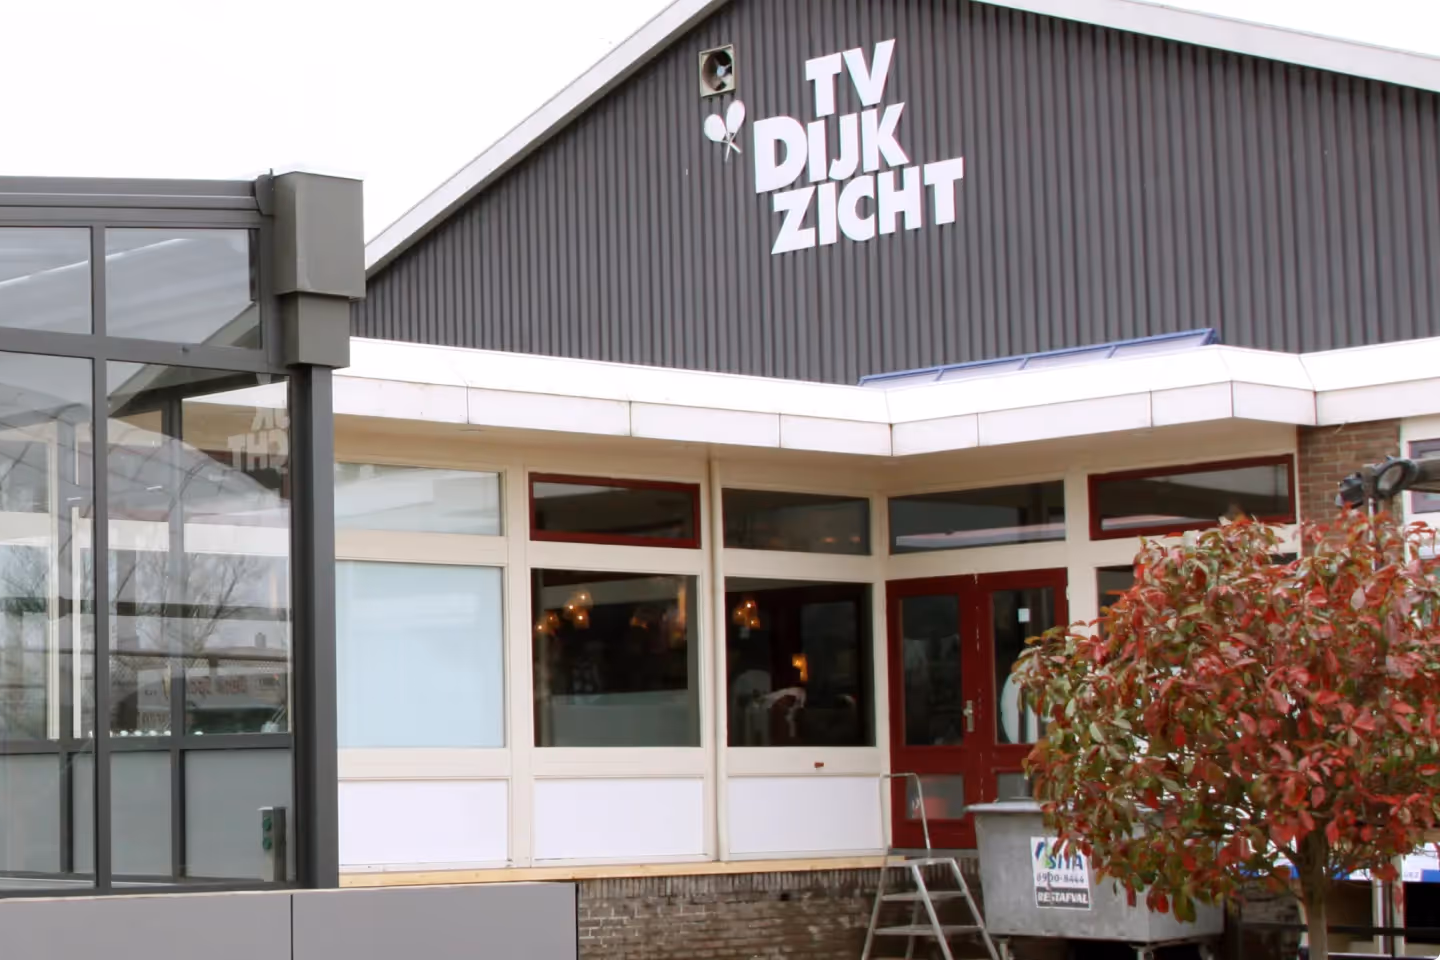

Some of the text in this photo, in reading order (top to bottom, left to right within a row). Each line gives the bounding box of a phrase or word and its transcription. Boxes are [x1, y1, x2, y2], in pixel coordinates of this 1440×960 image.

[805, 38, 895, 118] TV
[753, 102, 909, 193] DIJK
[771, 157, 963, 254] ZICHT
